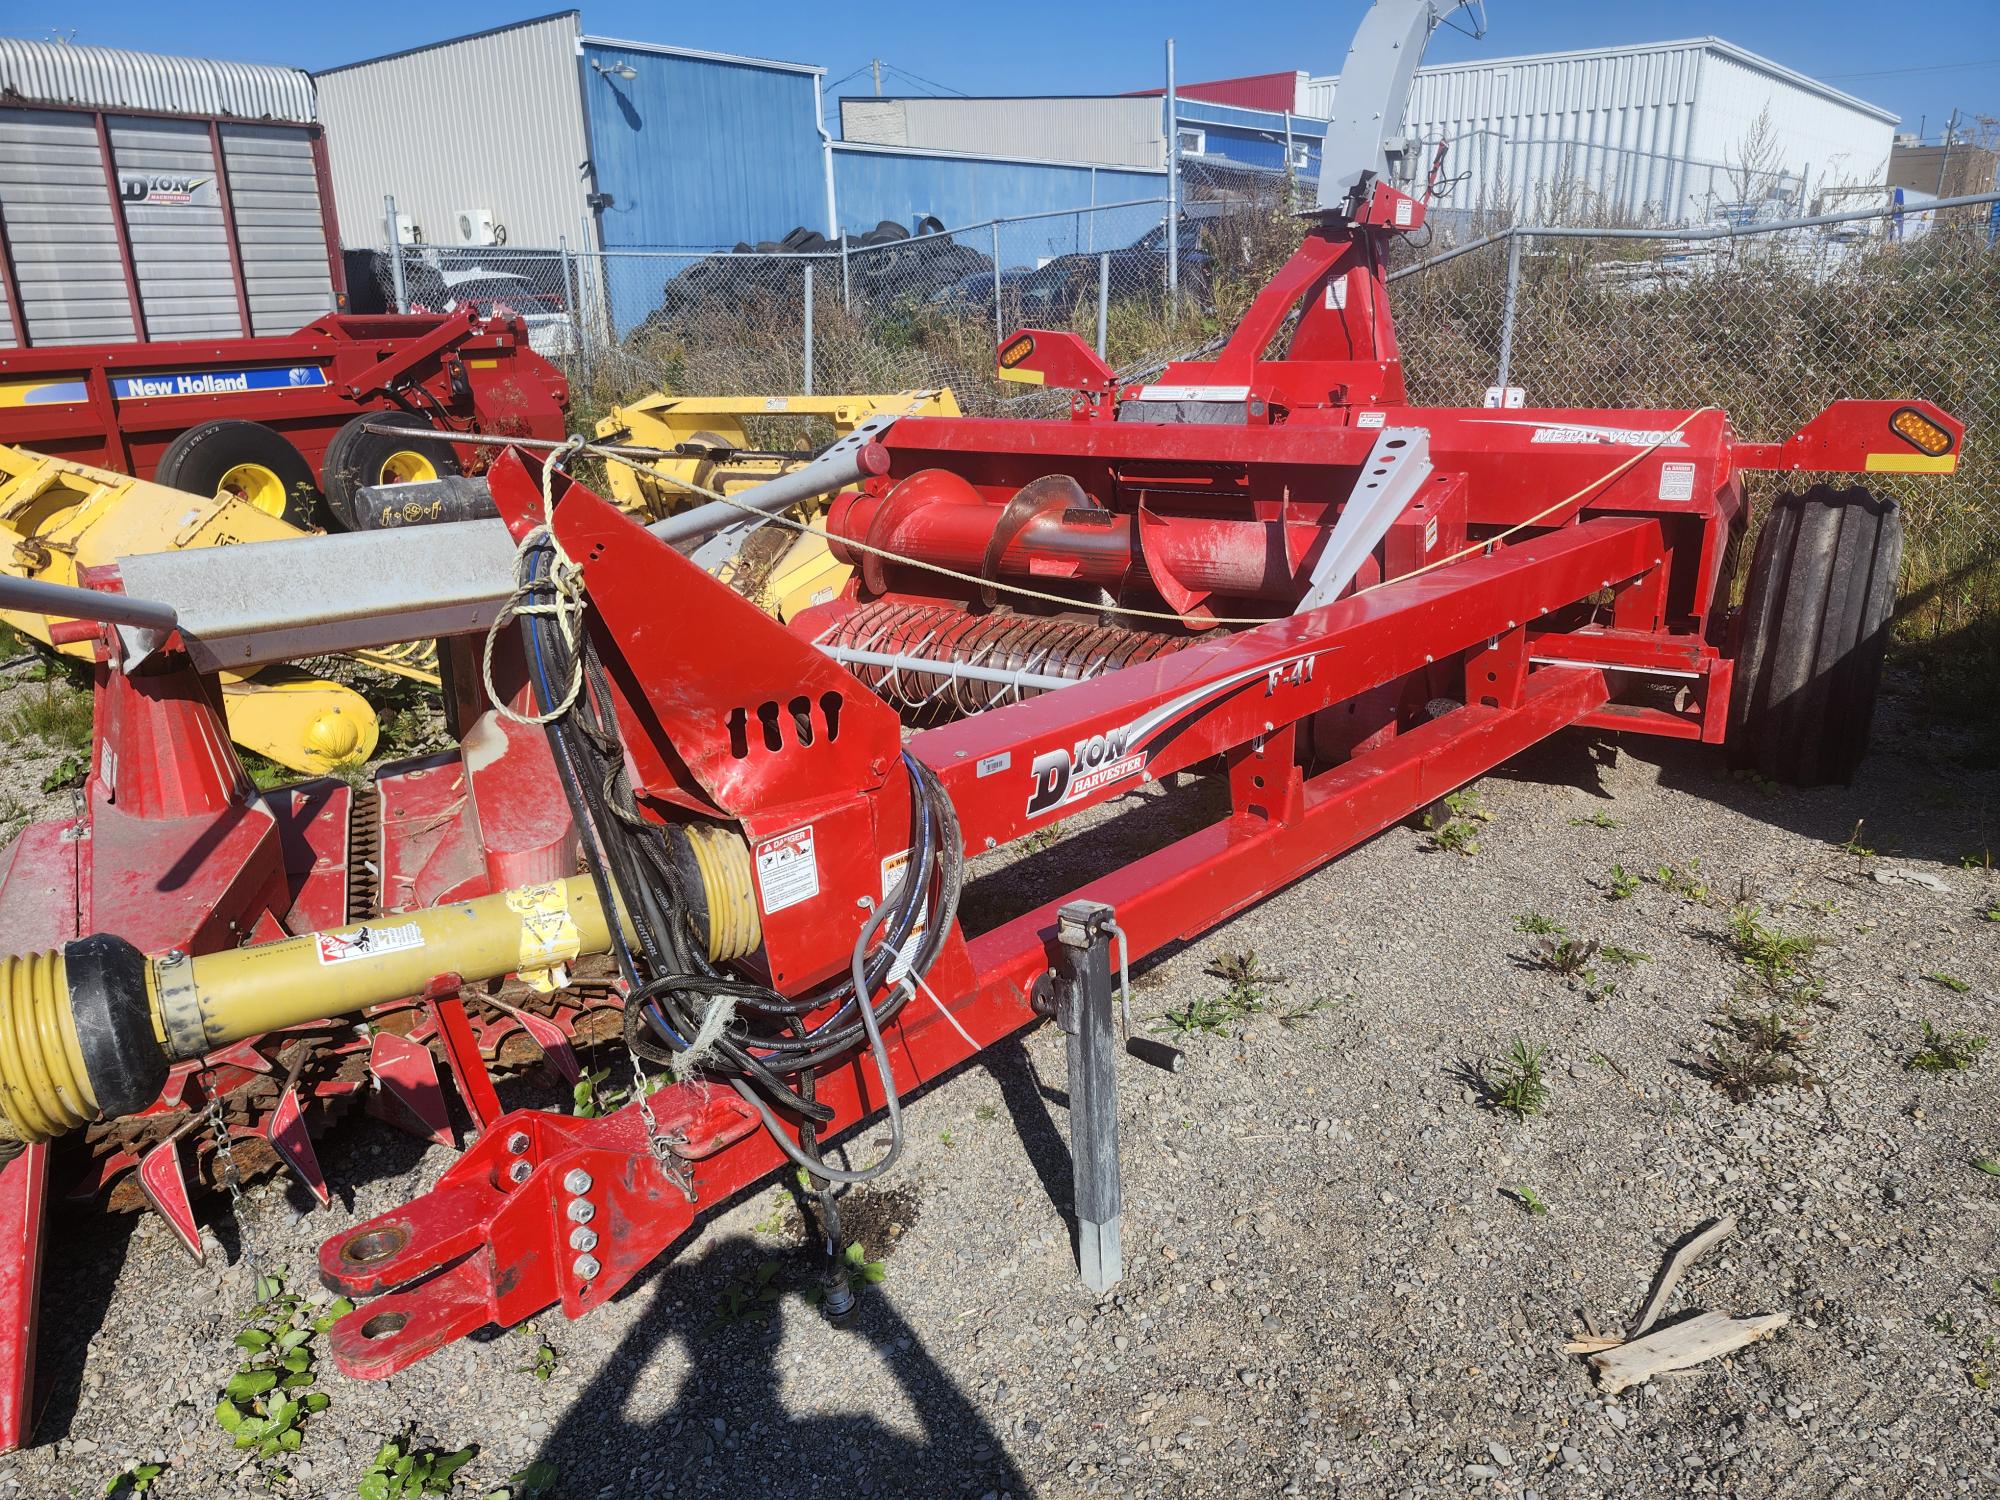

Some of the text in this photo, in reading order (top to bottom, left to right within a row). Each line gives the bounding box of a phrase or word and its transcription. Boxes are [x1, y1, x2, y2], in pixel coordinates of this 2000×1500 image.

[120, 177, 191, 201] DION
[128, 373, 248, 397] New Holland
[1531, 428, 1684, 444] METAL VISION
[1264, 656, 1315, 698] F-41
[1026, 724, 1133, 818] DION
[1074, 758, 1142, 795] HARVESTER
[773, 831, 805, 848] DANGER
